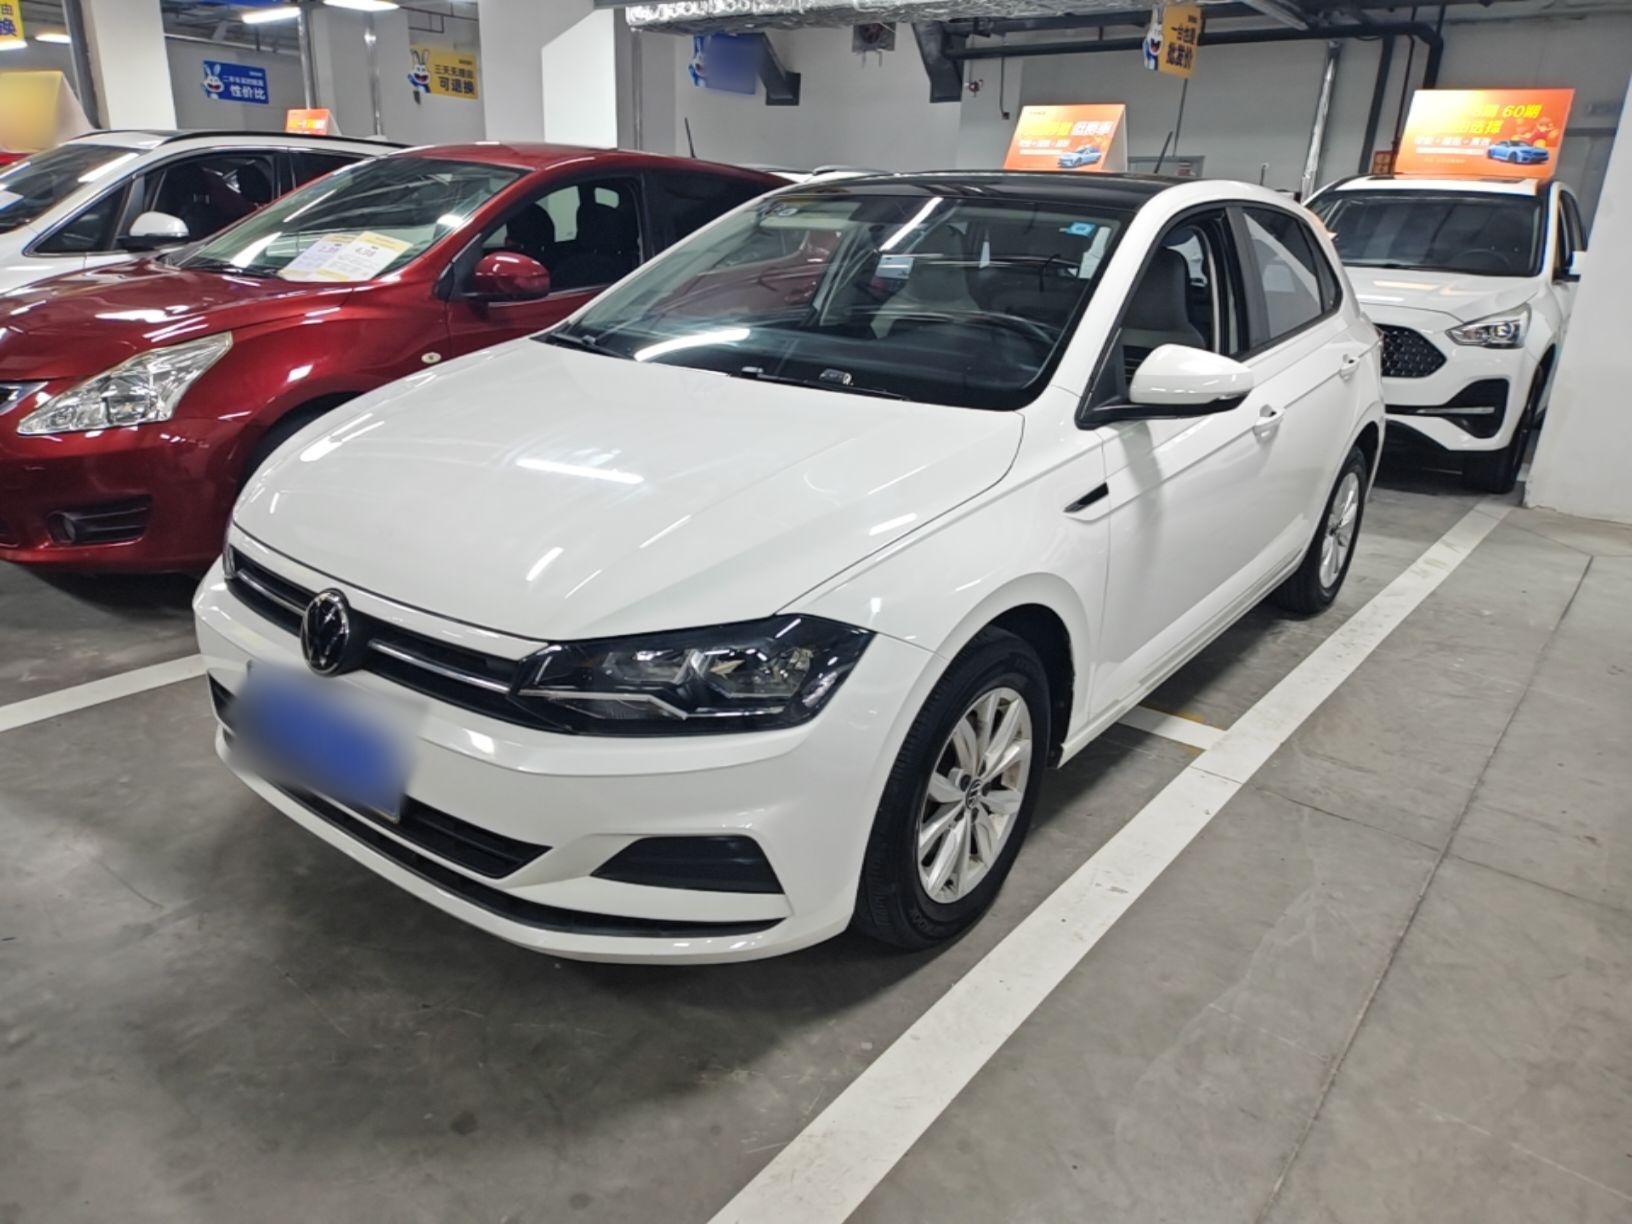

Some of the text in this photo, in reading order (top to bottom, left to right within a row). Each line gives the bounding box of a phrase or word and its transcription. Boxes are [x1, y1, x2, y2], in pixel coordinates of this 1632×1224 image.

[229, 84, 266, 99] 性价比
[438, 76, 475, 94] 可退换
[1502, 104, 1543, 118] 60期
